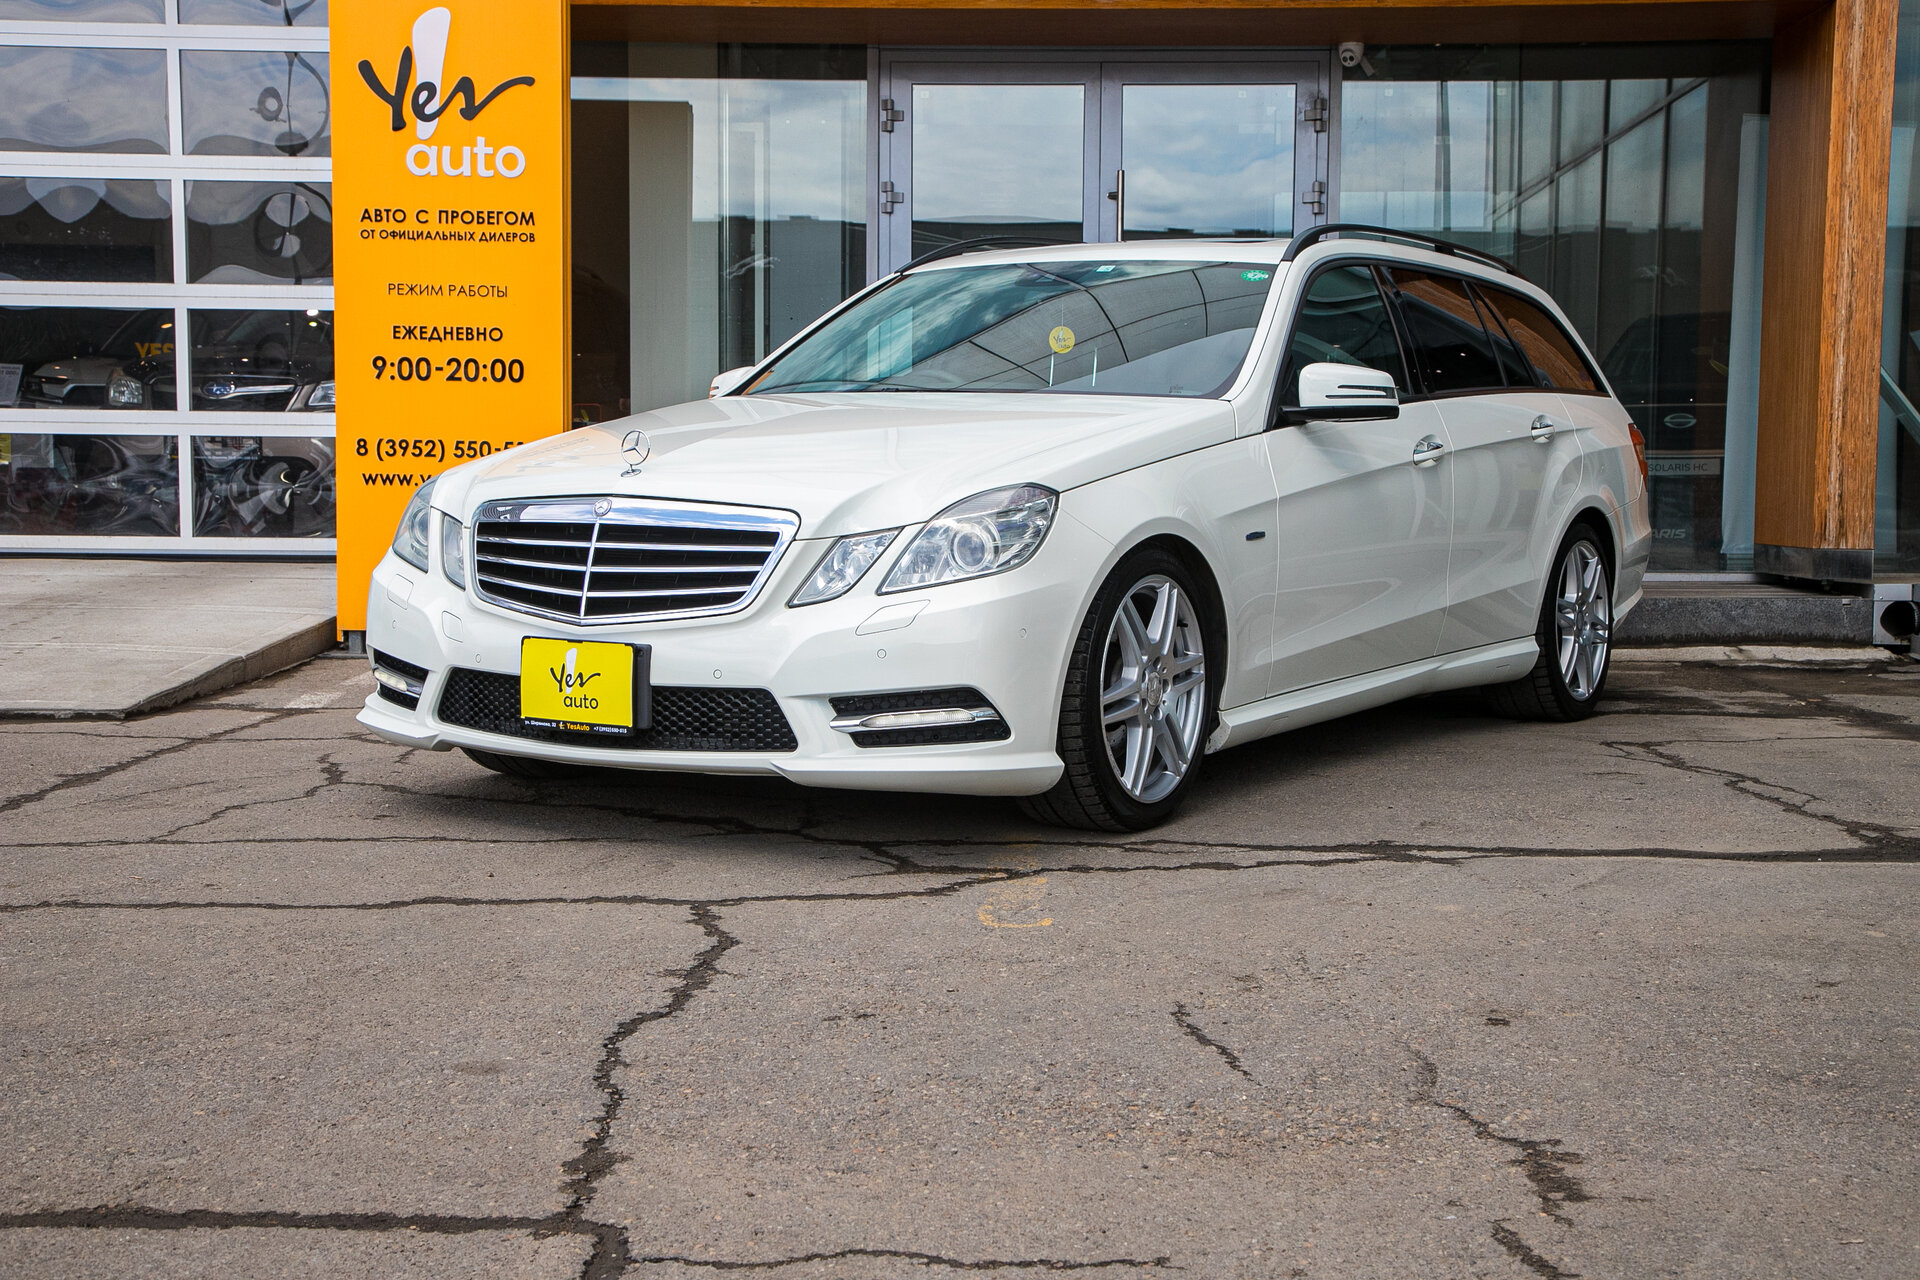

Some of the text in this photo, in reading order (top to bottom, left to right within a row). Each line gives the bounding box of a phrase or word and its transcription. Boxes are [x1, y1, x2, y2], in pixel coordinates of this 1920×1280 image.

[405, 136, 526, 178] auto
[360, 208, 535, 226] АВТО С ПРОБЕГОМ
[360, 229, 535, 243] ОТ ОФИЦИАЛЬНЫХ ДИЛЕРОВ
[388, 283, 507, 298] РЕЖИМ РАБОТЫ
[392, 325, 503, 342] ЕЖЕДНЕВНО
[371, 355, 525, 383] 9:00-20:00
[356, 438, 368, 456] 8
[376, 437, 446, 463] (3952)
[1648, 463, 1691, 472] SOLARIS
[550, 663, 601, 693] Yes
[563, 694, 599, 709] auto
[566, 723, 590, 731] YesAuto
